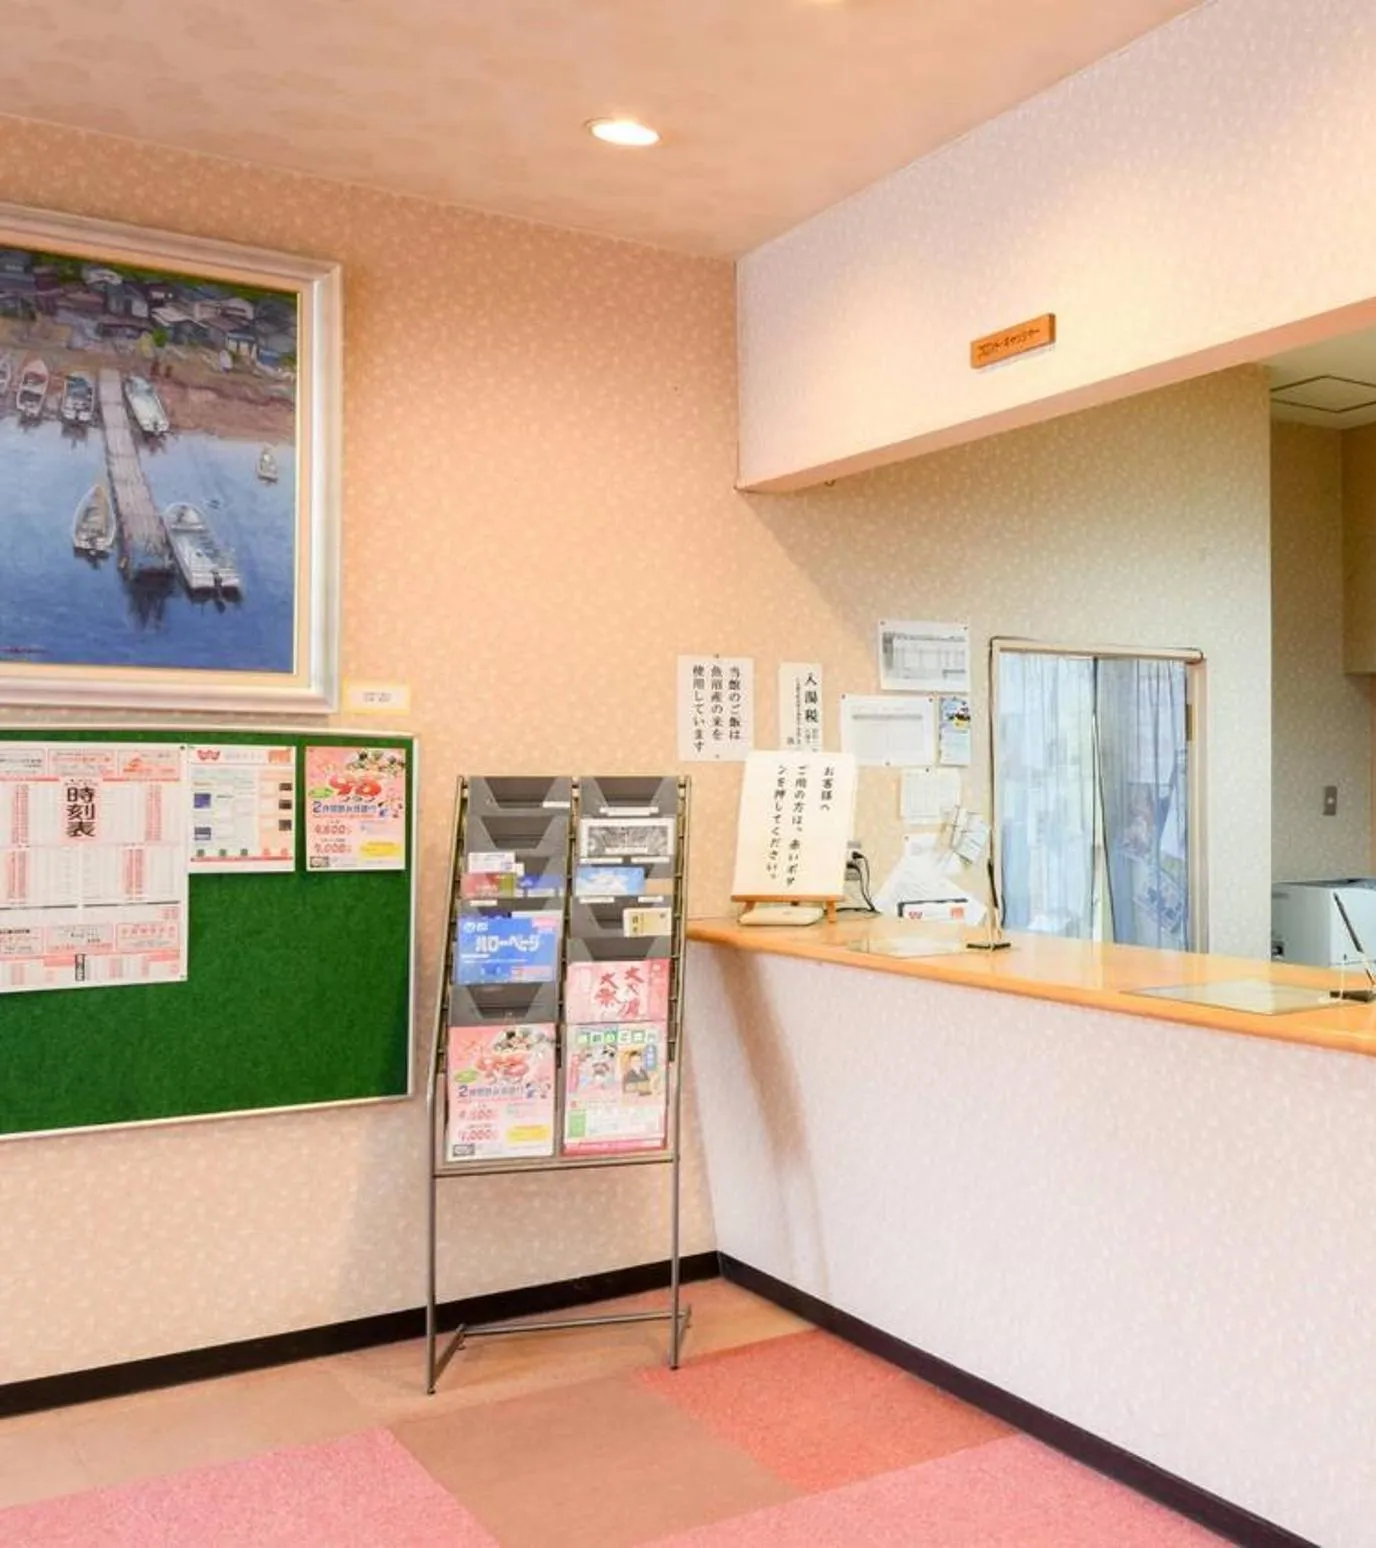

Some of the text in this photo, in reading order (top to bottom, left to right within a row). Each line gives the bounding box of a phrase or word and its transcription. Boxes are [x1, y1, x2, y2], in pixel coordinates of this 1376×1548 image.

[66, 786, 96, 838] 時刻表
[820, 766, 834, 811] お客様へ
